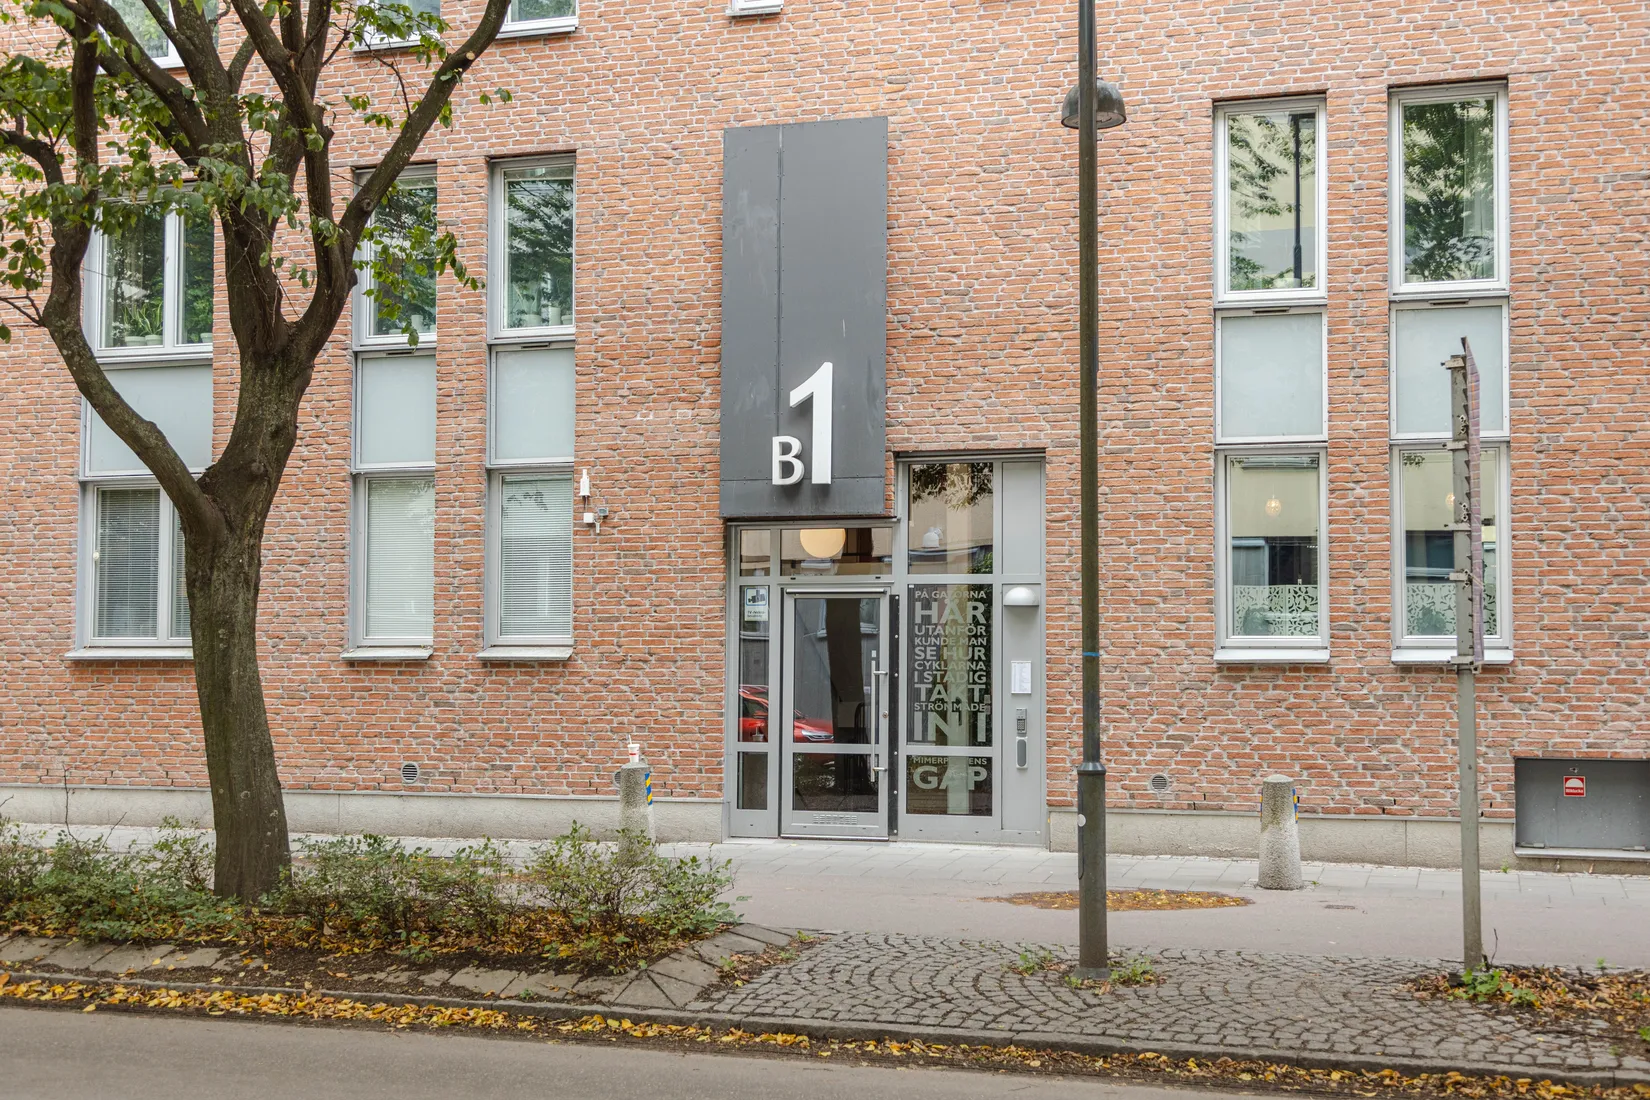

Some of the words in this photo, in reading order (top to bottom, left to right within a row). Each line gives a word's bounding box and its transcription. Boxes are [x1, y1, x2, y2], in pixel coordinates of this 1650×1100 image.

[915, 588, 929, 599] PÅ
[915, 598, 987, 624] HÄR
[915, 623, 987, 636] UTANFÖR
[915, 637, 956, 646] KUNDE
[959, 637, 987, 646] MAN
[915, 646, 937, 660] SE
[943, 647, 987, 661] HUR
[914, 660, 986, 671] CYKLARNA
[923, 671, 987, 683] STADIG
[914, 683, 986, 703] TAKT
[912, 756, 988, 765] MIMERPENS
